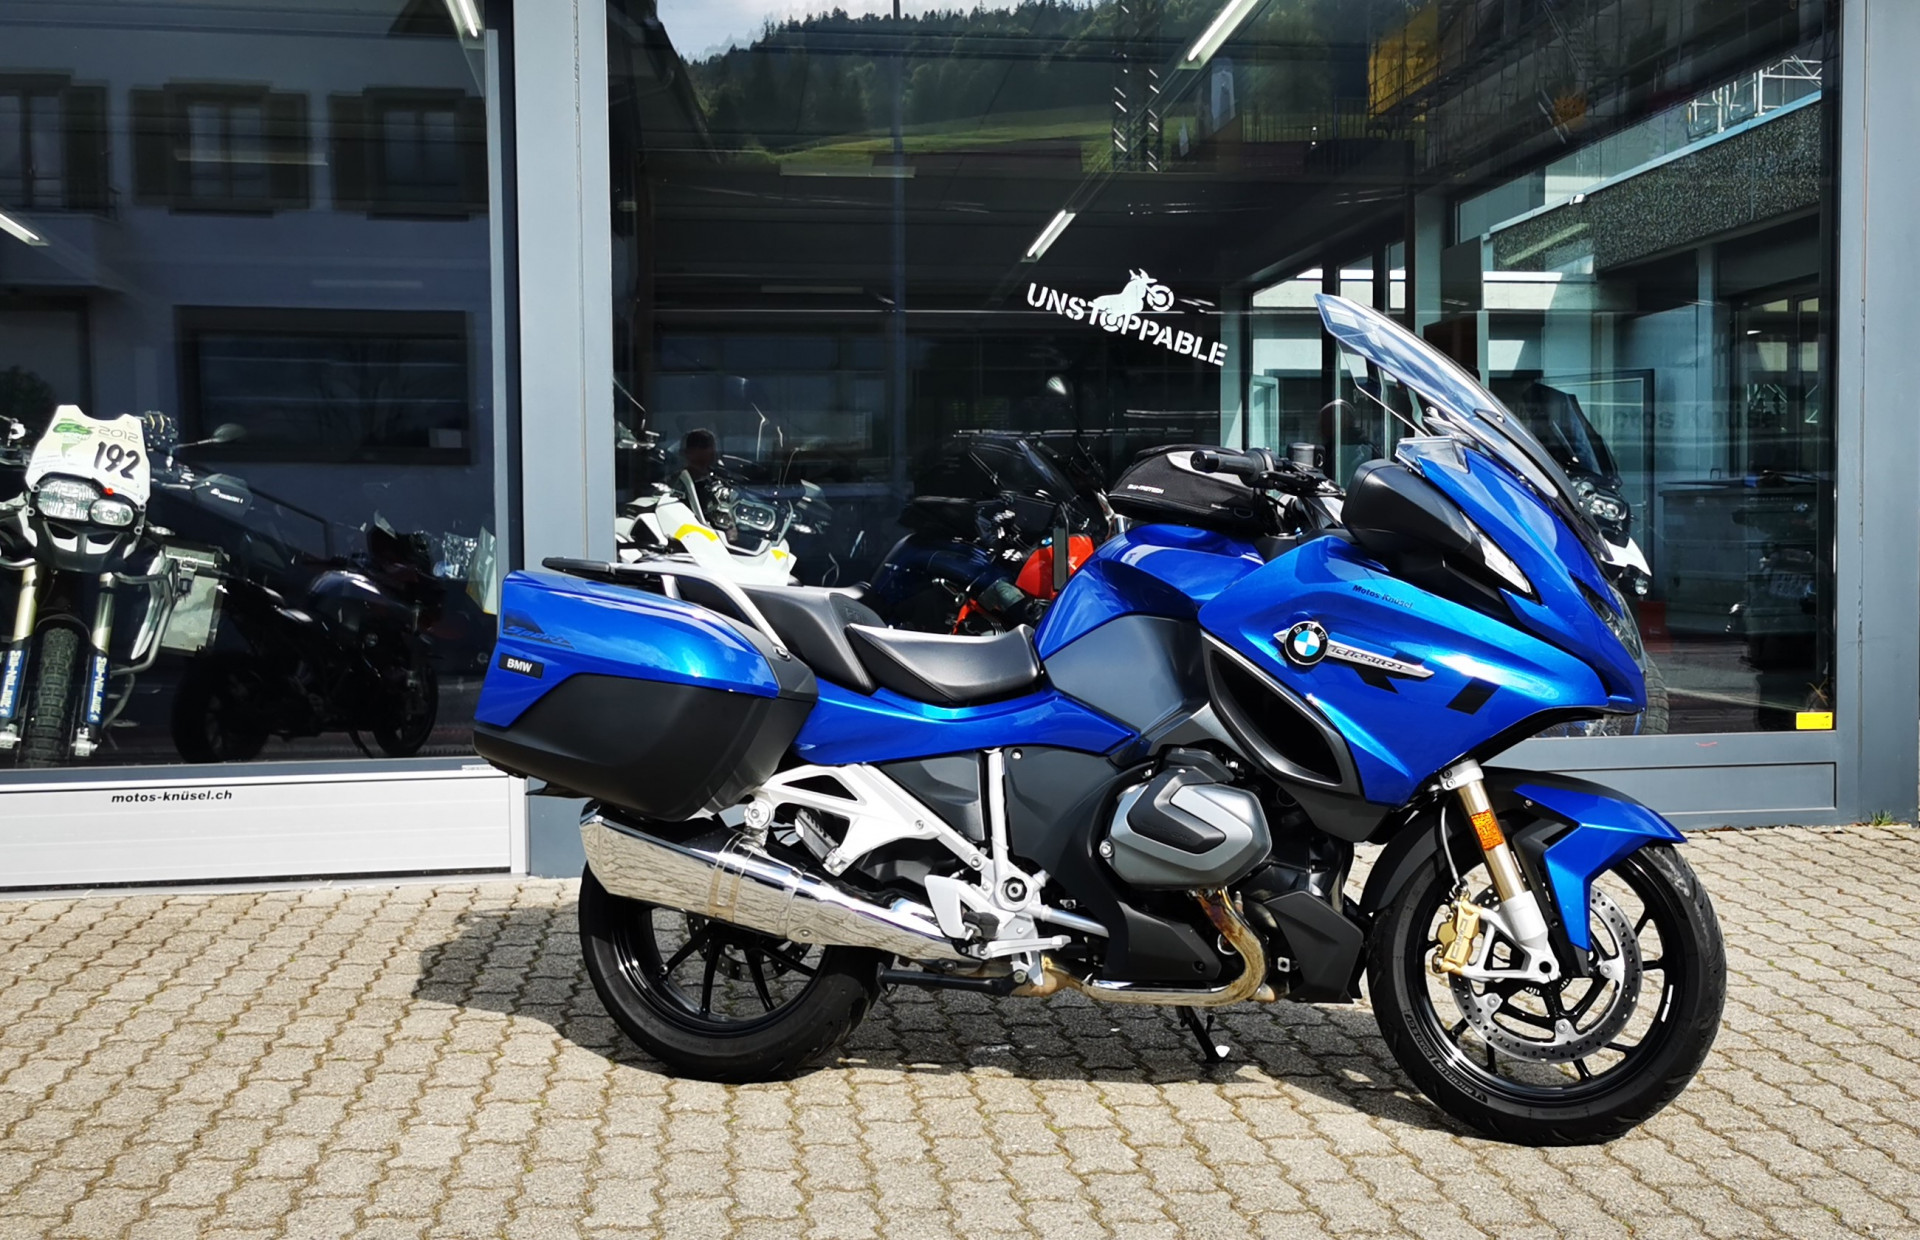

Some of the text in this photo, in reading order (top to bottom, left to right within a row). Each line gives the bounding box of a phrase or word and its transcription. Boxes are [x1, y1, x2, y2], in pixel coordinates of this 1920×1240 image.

[1027, 282, 1229, 367] UNSTOPPABLE
[98, 425, 139, 444] 2012
[94, 440, 141, 480] 192
[1352, 584, 1380, 599] Motos
[1293, 623, 1326, 641] BMW
[506, 658, 533, 673] BMW
[111, 790, 233, 803] motos-knüsel.ch
[1416, 1035, 1433, 1057] ROAD
[1435, 1062, 1474, 1094] MICHELIN
